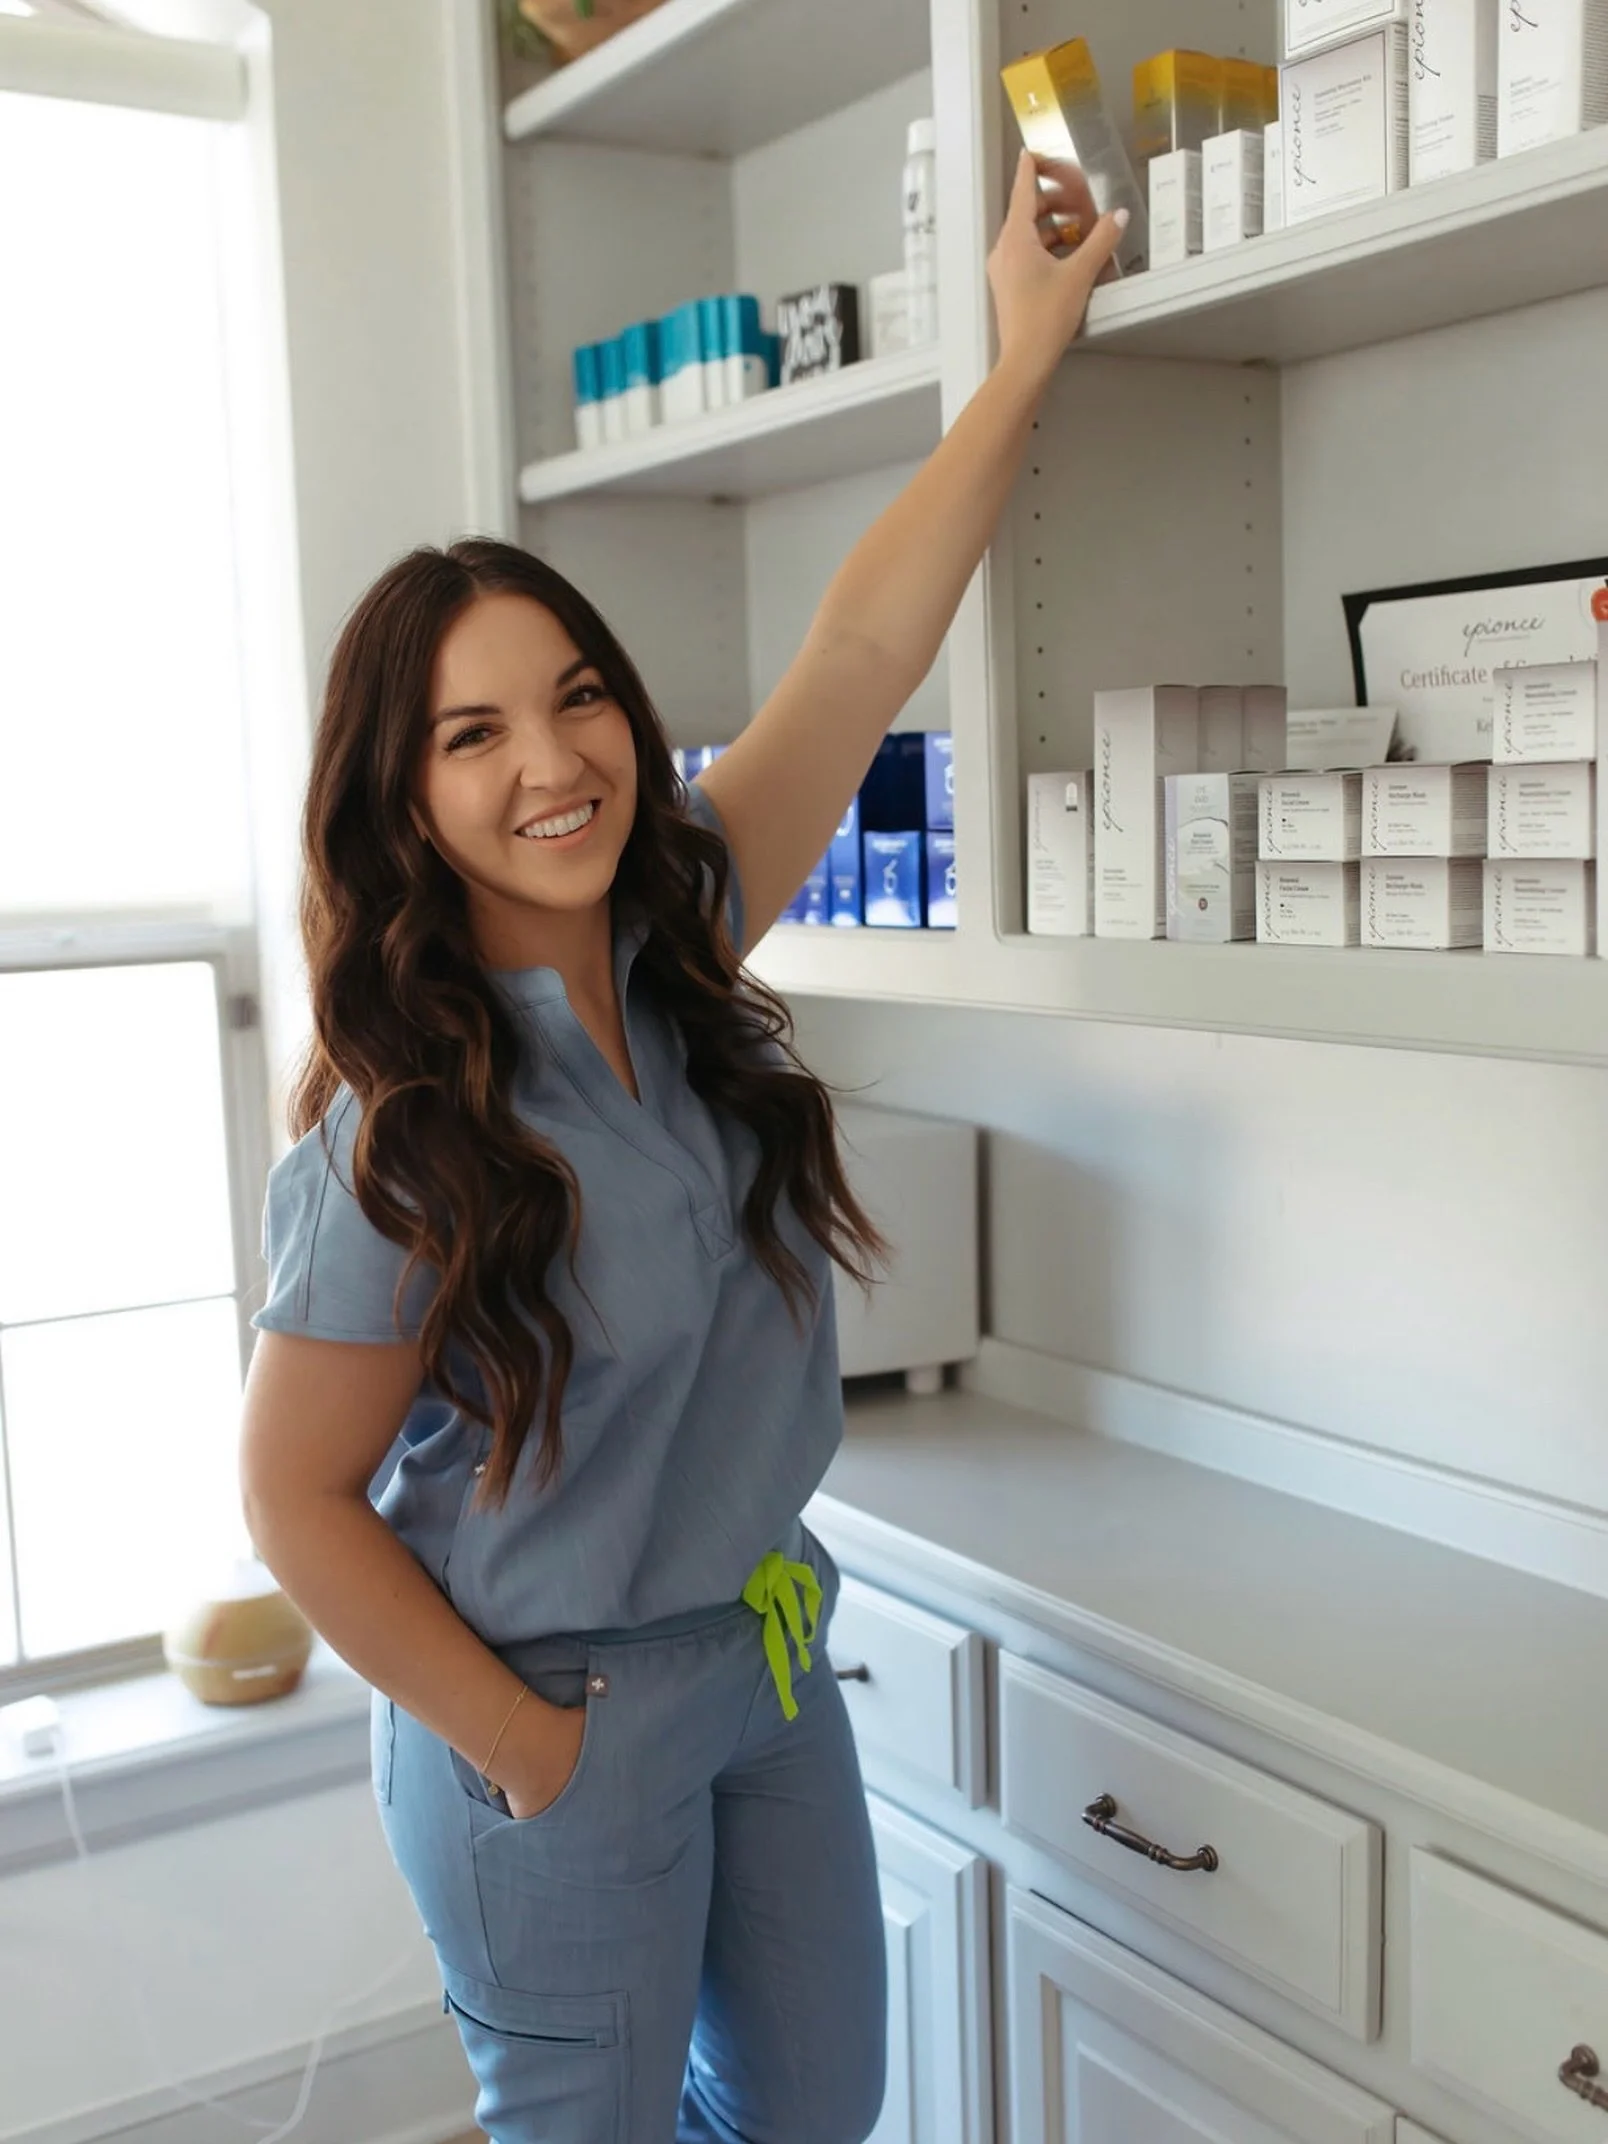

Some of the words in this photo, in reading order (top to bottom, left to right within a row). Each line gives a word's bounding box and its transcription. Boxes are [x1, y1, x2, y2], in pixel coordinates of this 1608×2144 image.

[1292, 82, 1317, 187] epionce
[1462, 615, 1546, 658] epionce
[1400, 665, 1489, 690] Certificate
[1503, 677, 1523, 755] epionce
[1102, 729, 1124, 833] epionce
[1371, 776, 1388, 851] epionce
[1499, 775, 1519, 852] epionce
[1267, 783, 1283, 855] epionce
[1265, 867, 1281, 940] epionce
[1368, 866, 1385, 941] epionce
[1494, 868, 1514, 947] epionce
